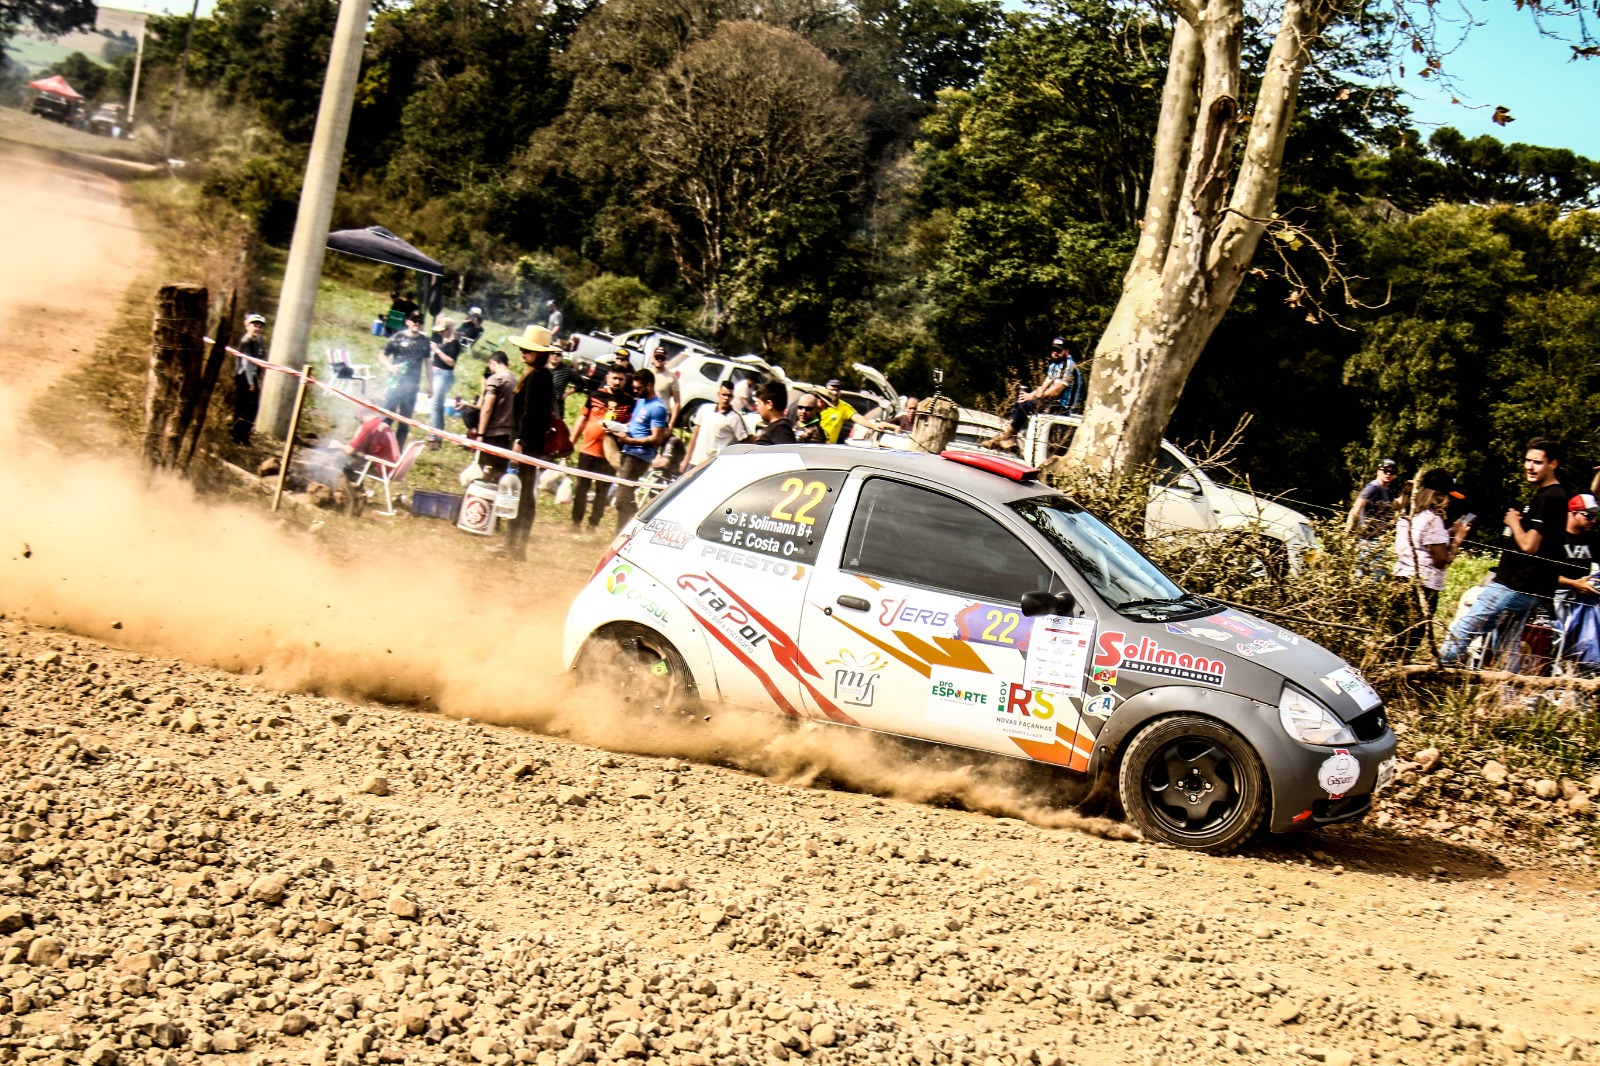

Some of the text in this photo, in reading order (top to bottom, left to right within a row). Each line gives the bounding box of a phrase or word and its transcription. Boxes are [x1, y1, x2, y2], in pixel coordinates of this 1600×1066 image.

[771, 478, 827, 525] 22
[655, 530, 690, 545] RALLY
[738, 512, 812, 538] F. Solimann B+
[732, 530, 744, 546] F.
[745, 532, 780, 552] Costa
[701, 545, 790, 576] PRESTO
[712, 616, 726, 629] para
[726, 627, 754, 653] escritório
[982, 609, 1021, 644] 22
[1094, 631, 1225, 675] Solimann
[1125, 661, 1220, 683] Empreendimentos
[932, 685, 987, 704] ESPORTE
[1007, 682, 1055, 719] RS
[996, 717, 1053, 732] NOVAS FAÇANHAS
